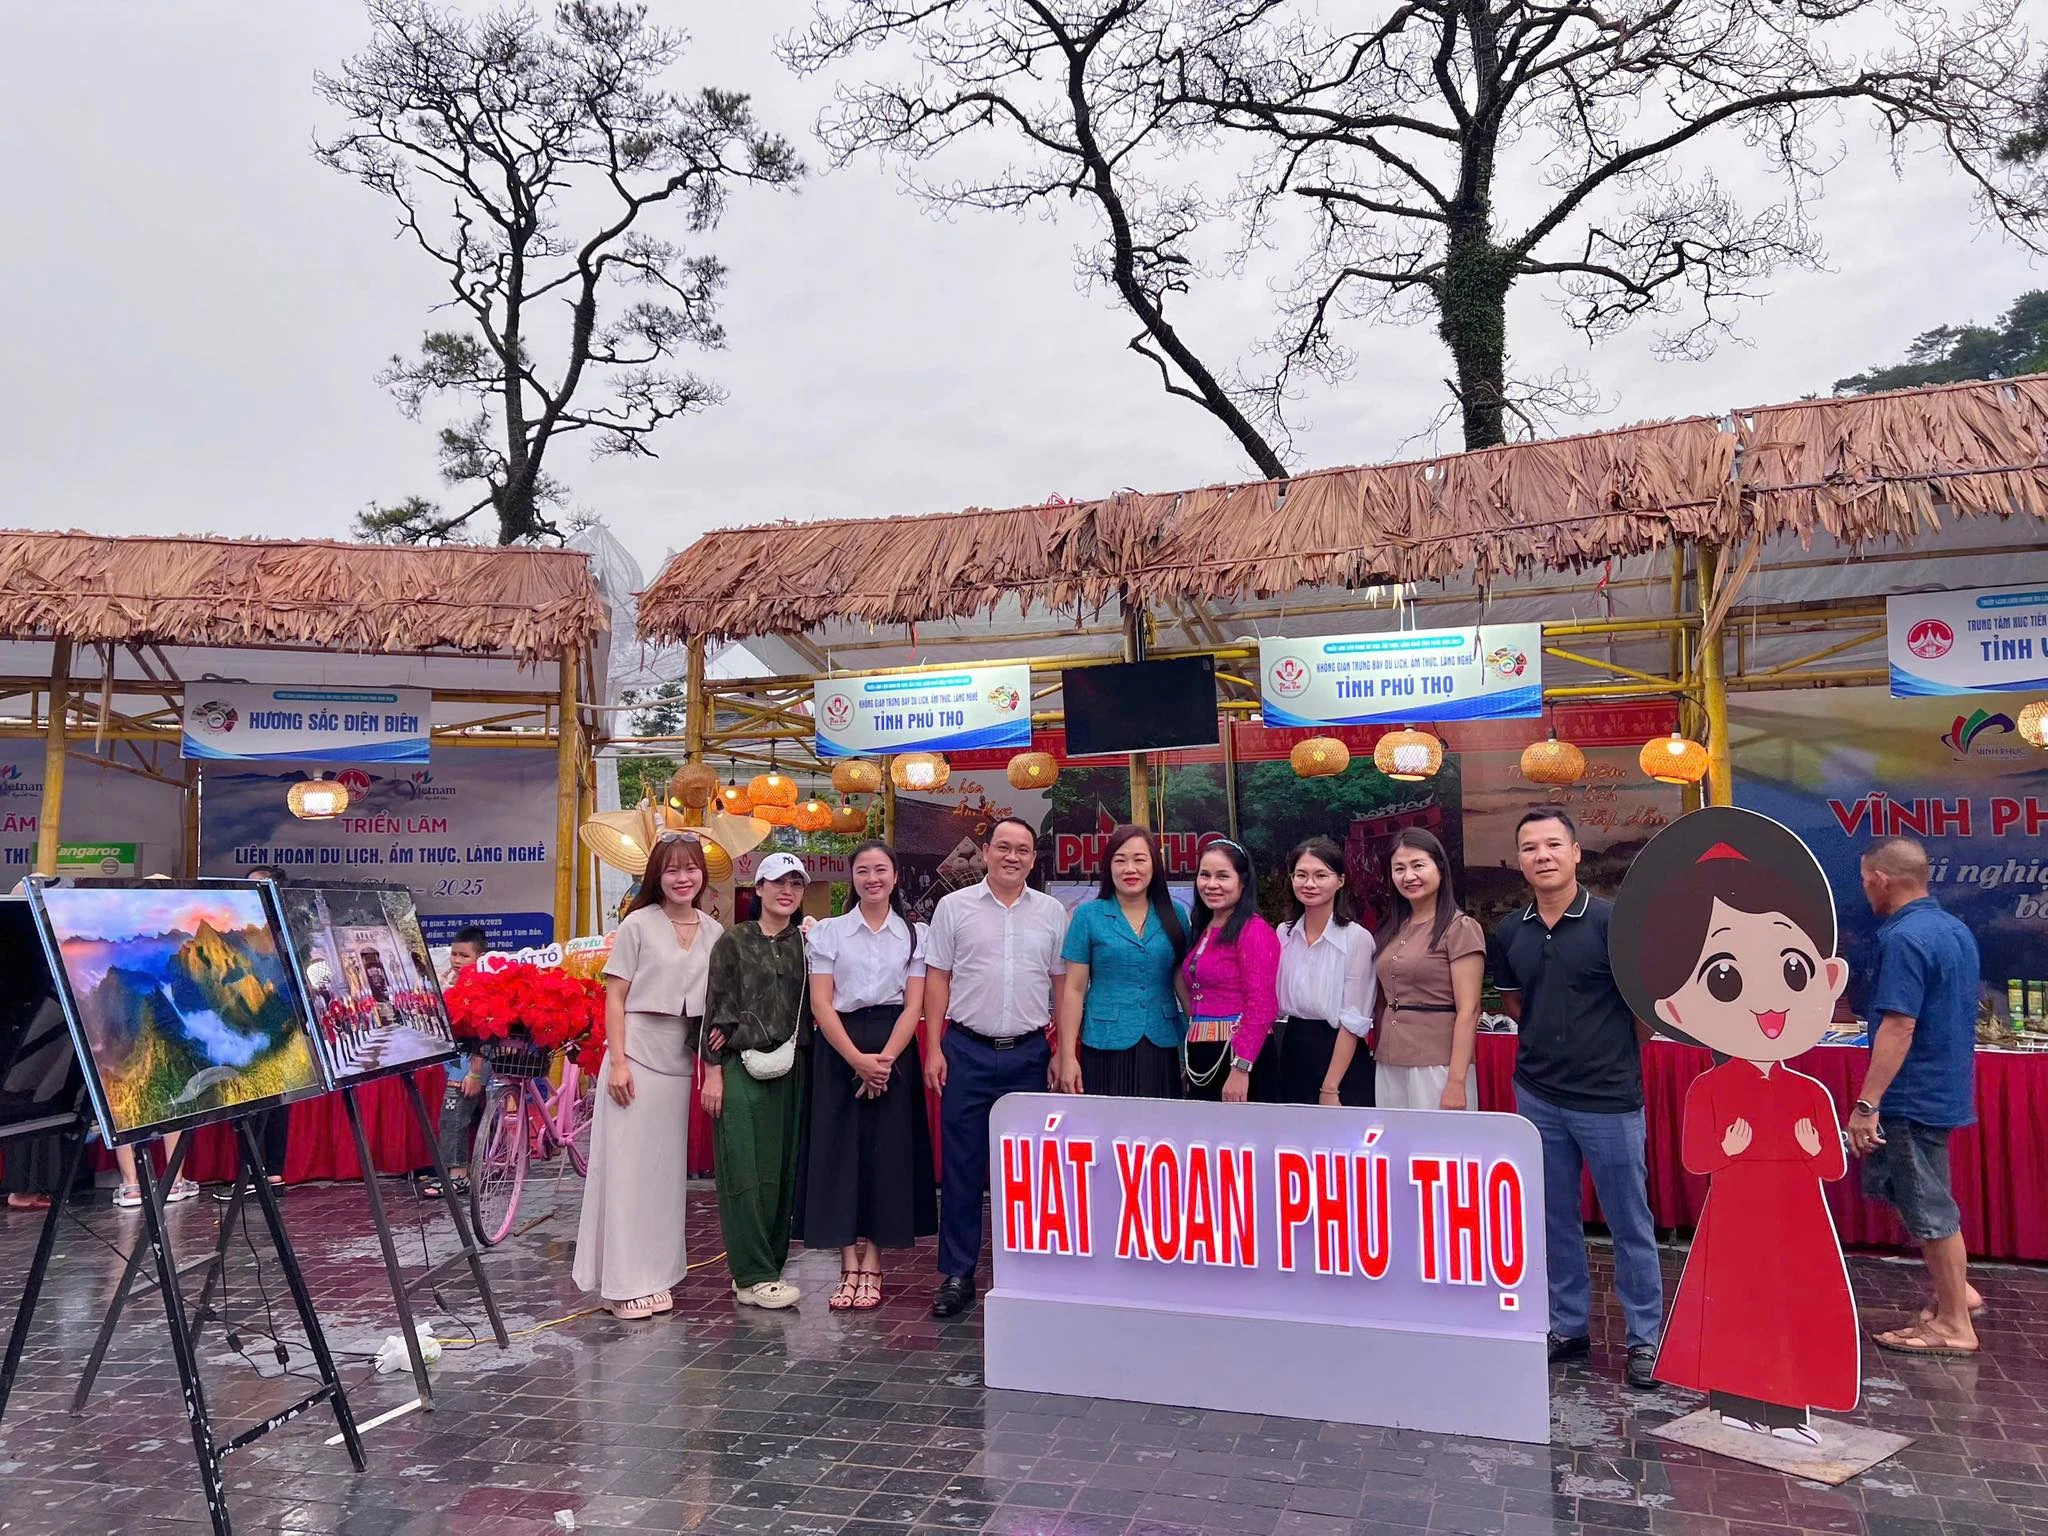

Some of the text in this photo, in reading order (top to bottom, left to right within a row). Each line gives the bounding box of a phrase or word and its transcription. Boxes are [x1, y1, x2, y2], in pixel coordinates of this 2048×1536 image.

[1968, 619, 1992, 632] TRUNG
[1994, 615, 2011, 630] TÂM
[1981, 635, 2032, 661] TỈNH
[1336, 674, 1454, 699] TỈNH PHÚ THỌ
[250, 708, 419, 736] HƯƠNG SẮC ĐIỆN BIÊN
[874, 709, 964, 731] TỈNH PHÚ THỌ
[0, 813, 37, 833] ÃM
[342, 810, 448, 834] TRIỂN LÃM
[1826, 791, 1972, 837] VĨNH
[235, 841, 546, 867] LIÊN HOAN DU LỊCH, ẨM THỰC, LÀNG NGHỀ
[820, 855, 845, 873] Phú
[1056, 832, 1112, 873] PH
[433, 879, 485, 897] 2025
[540, 946, 558, 964] TỔ
[999, 1113, 1528, 1311] HÁT XOAN PHÚ THỌ
